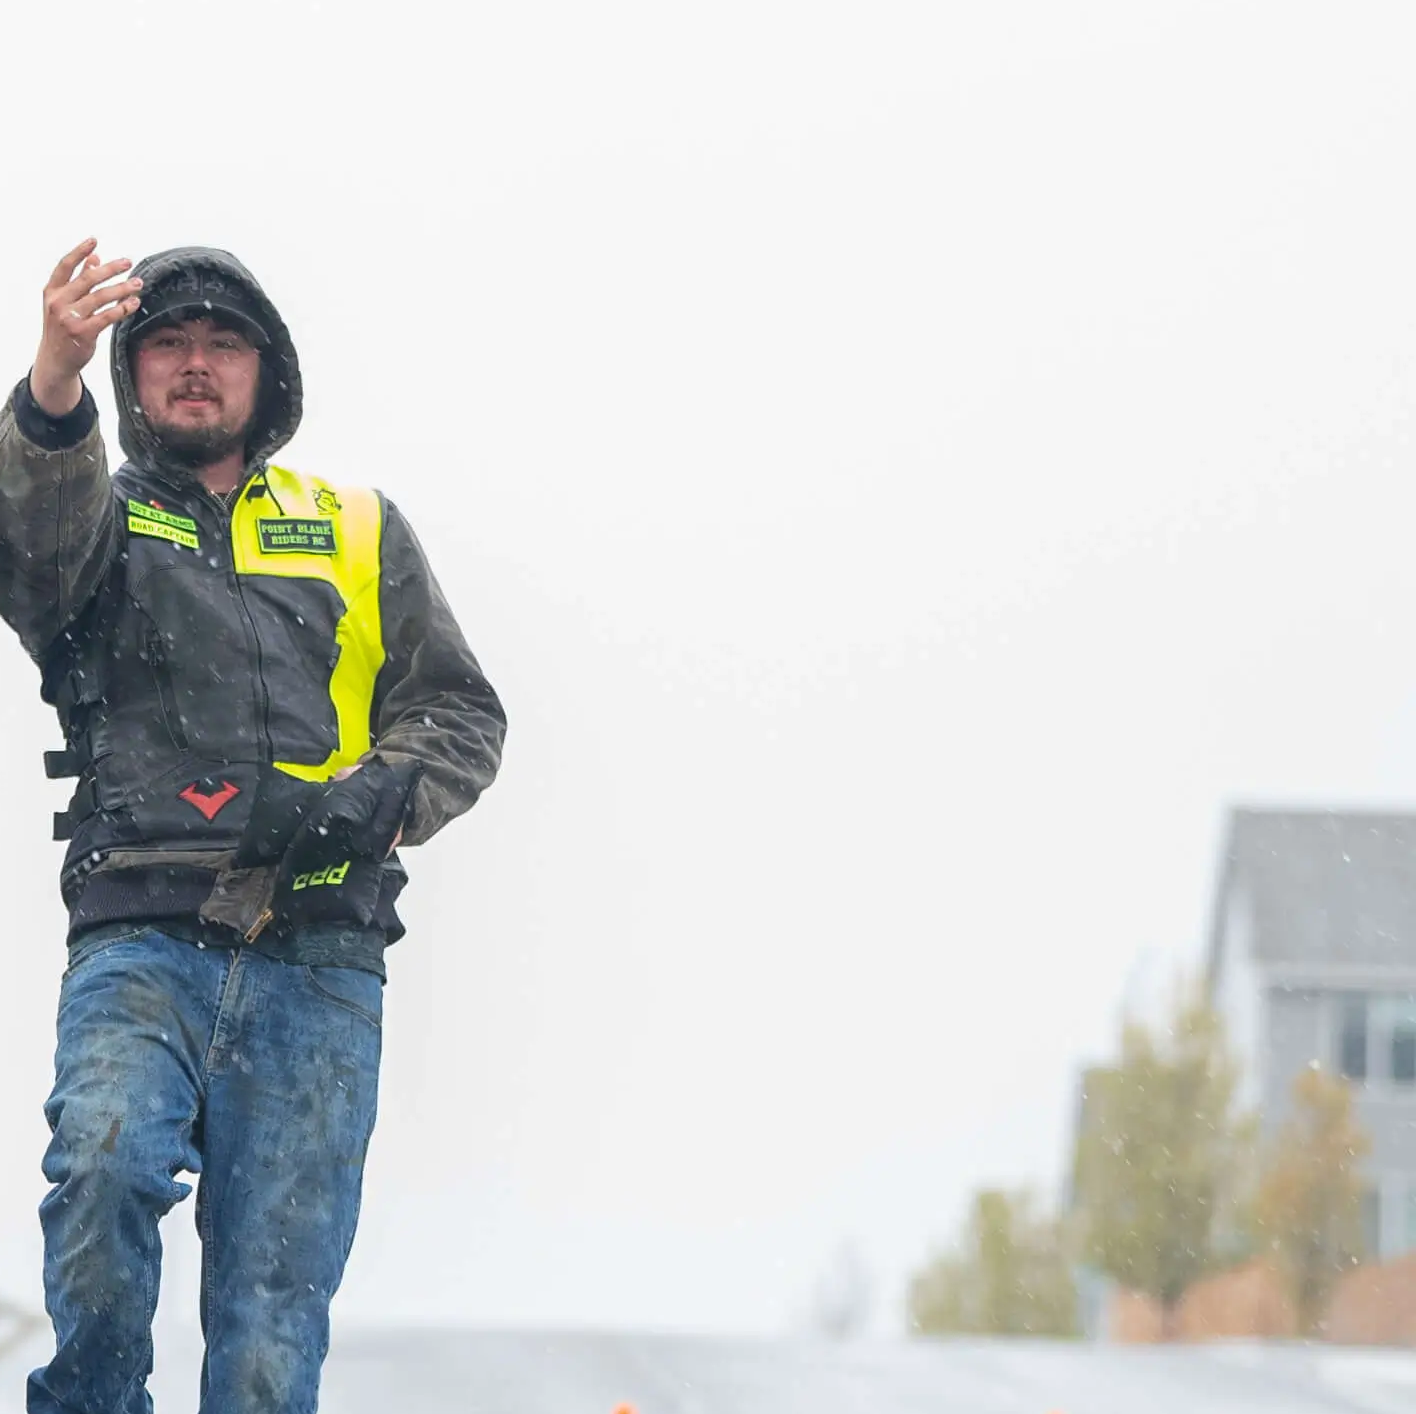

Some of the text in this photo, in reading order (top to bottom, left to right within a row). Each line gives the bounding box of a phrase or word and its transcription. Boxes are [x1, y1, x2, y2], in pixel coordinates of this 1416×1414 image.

[261, 523, 332, 536] POINT BLANK
[271, 535, 309, 545] RIDERS
